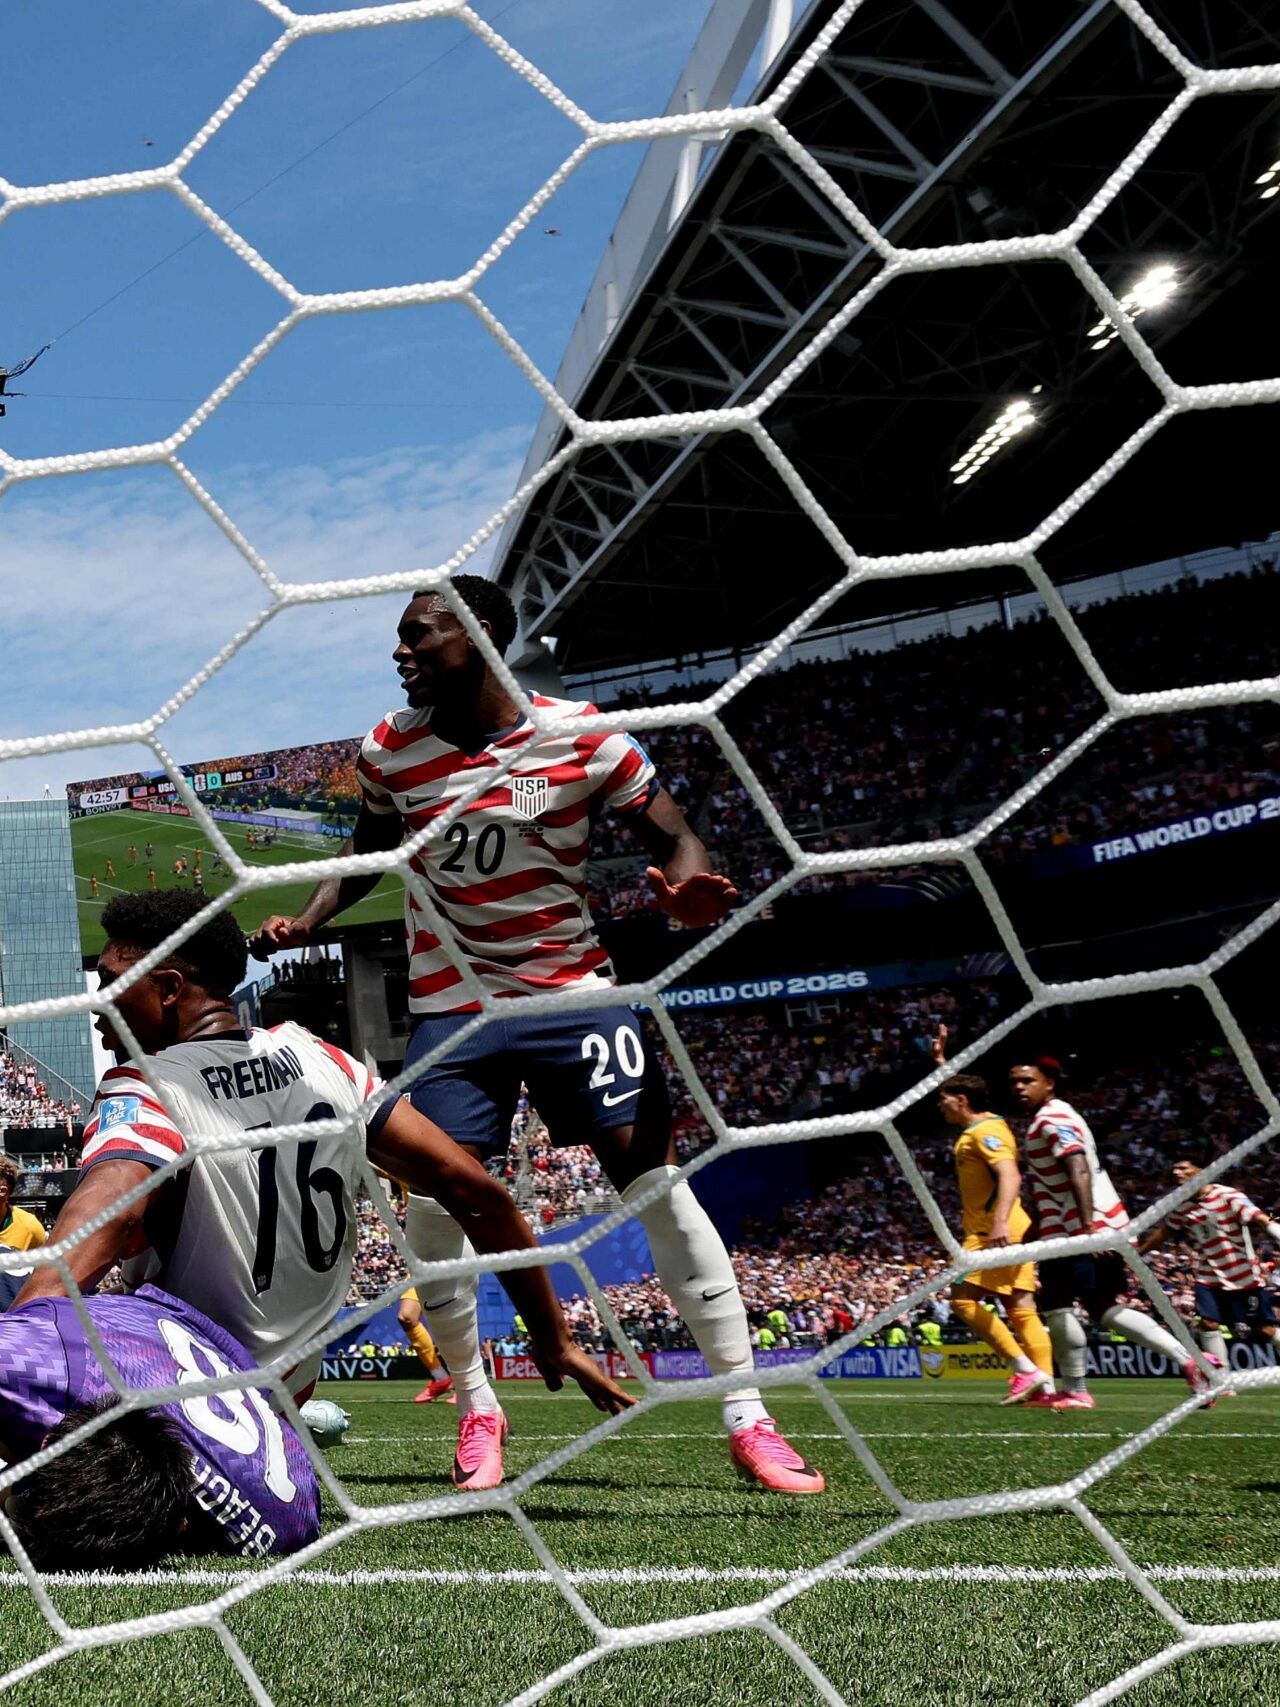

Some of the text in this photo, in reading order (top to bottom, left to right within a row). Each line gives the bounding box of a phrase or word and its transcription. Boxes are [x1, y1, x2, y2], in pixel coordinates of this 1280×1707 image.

[86, 791, 120, 805] 42:57
[157, 771, 243, 793] USA 0 AUS
[515, 780, 545, 795] USA
[333, 826, 352, 837] wth
[439, 821, 507, 875] 20
[1092, 836, 1138, 863] FIFA
[1135, 817, 1212, 851] WORLD
[1212, 803, 1258, 831] CUP
[658, 971, 868, 1007] WORLD CUP 2026
[200, 1045, 305, 1101] FREEMAN
[581, 1025, 646, 1090] 20
[244, 1101, 347, 1296] 16
[322, 1358, 393, 1379] NVOY
[502, 1357, 542, 1378] Beta
[877, 1349, 921, 1377] VISA
[1085, 1345, 1170, 1377] ARRIO
[157, 1318, 298, 1503] 18
[189, 1456, 278, 1558] BEACH
